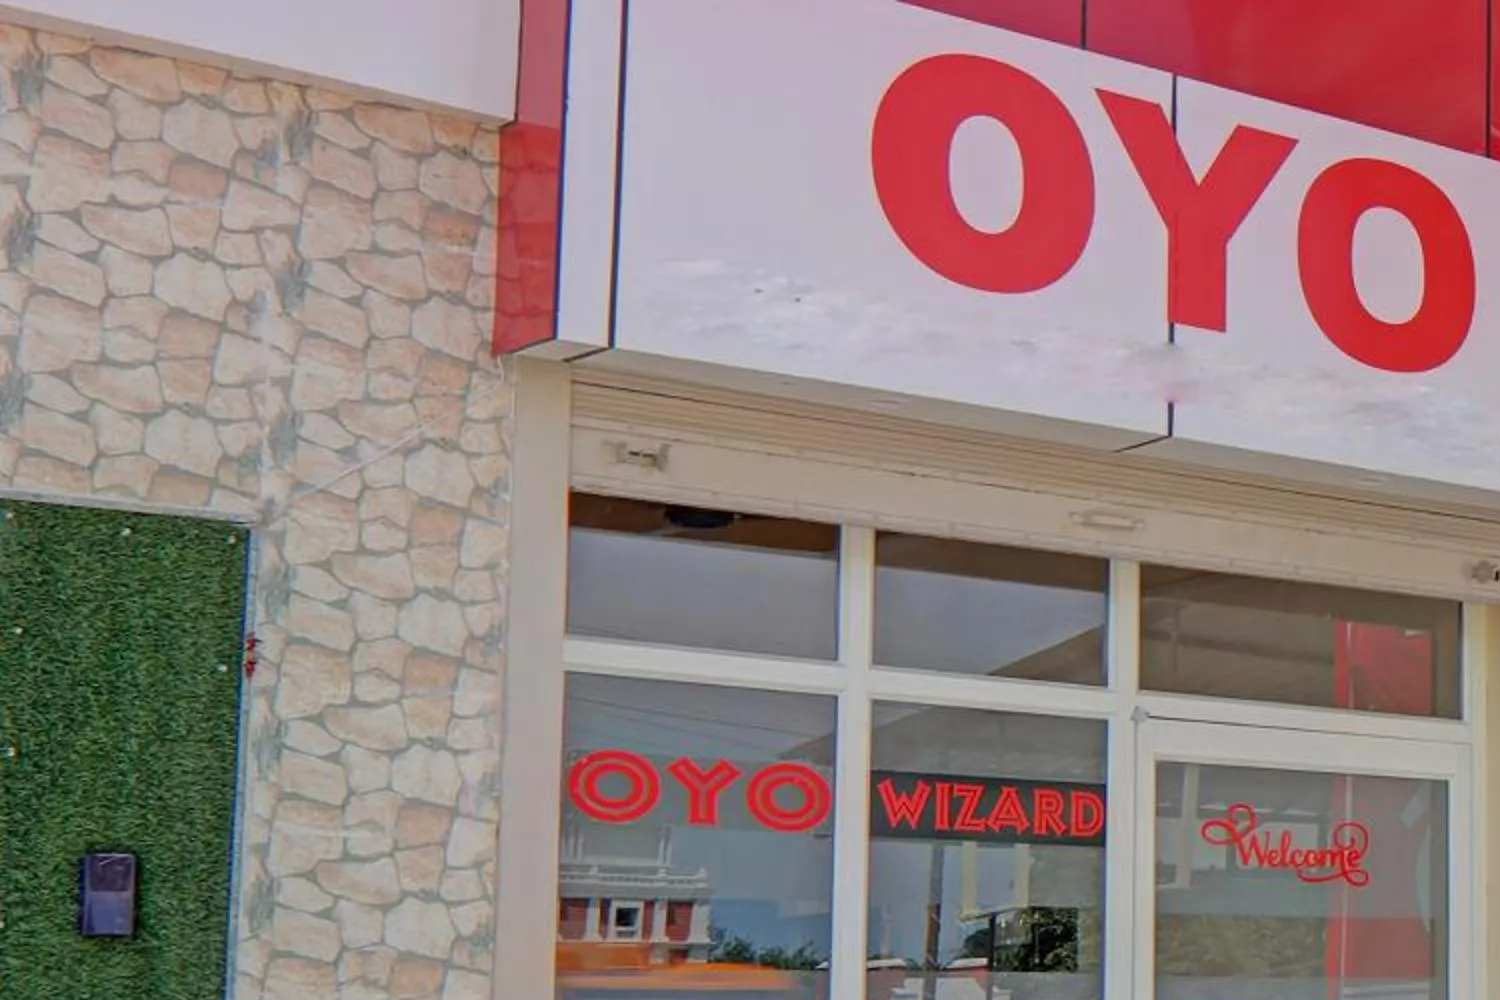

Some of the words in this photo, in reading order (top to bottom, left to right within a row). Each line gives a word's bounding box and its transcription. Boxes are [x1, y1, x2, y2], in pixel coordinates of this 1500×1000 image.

[871, 53, 1477, 373] OYO
[568, 749, 833, 833] OYO
[877, 777, 1105, 838] WIZARD
[1200, 803, 1370, 887] Welcome
